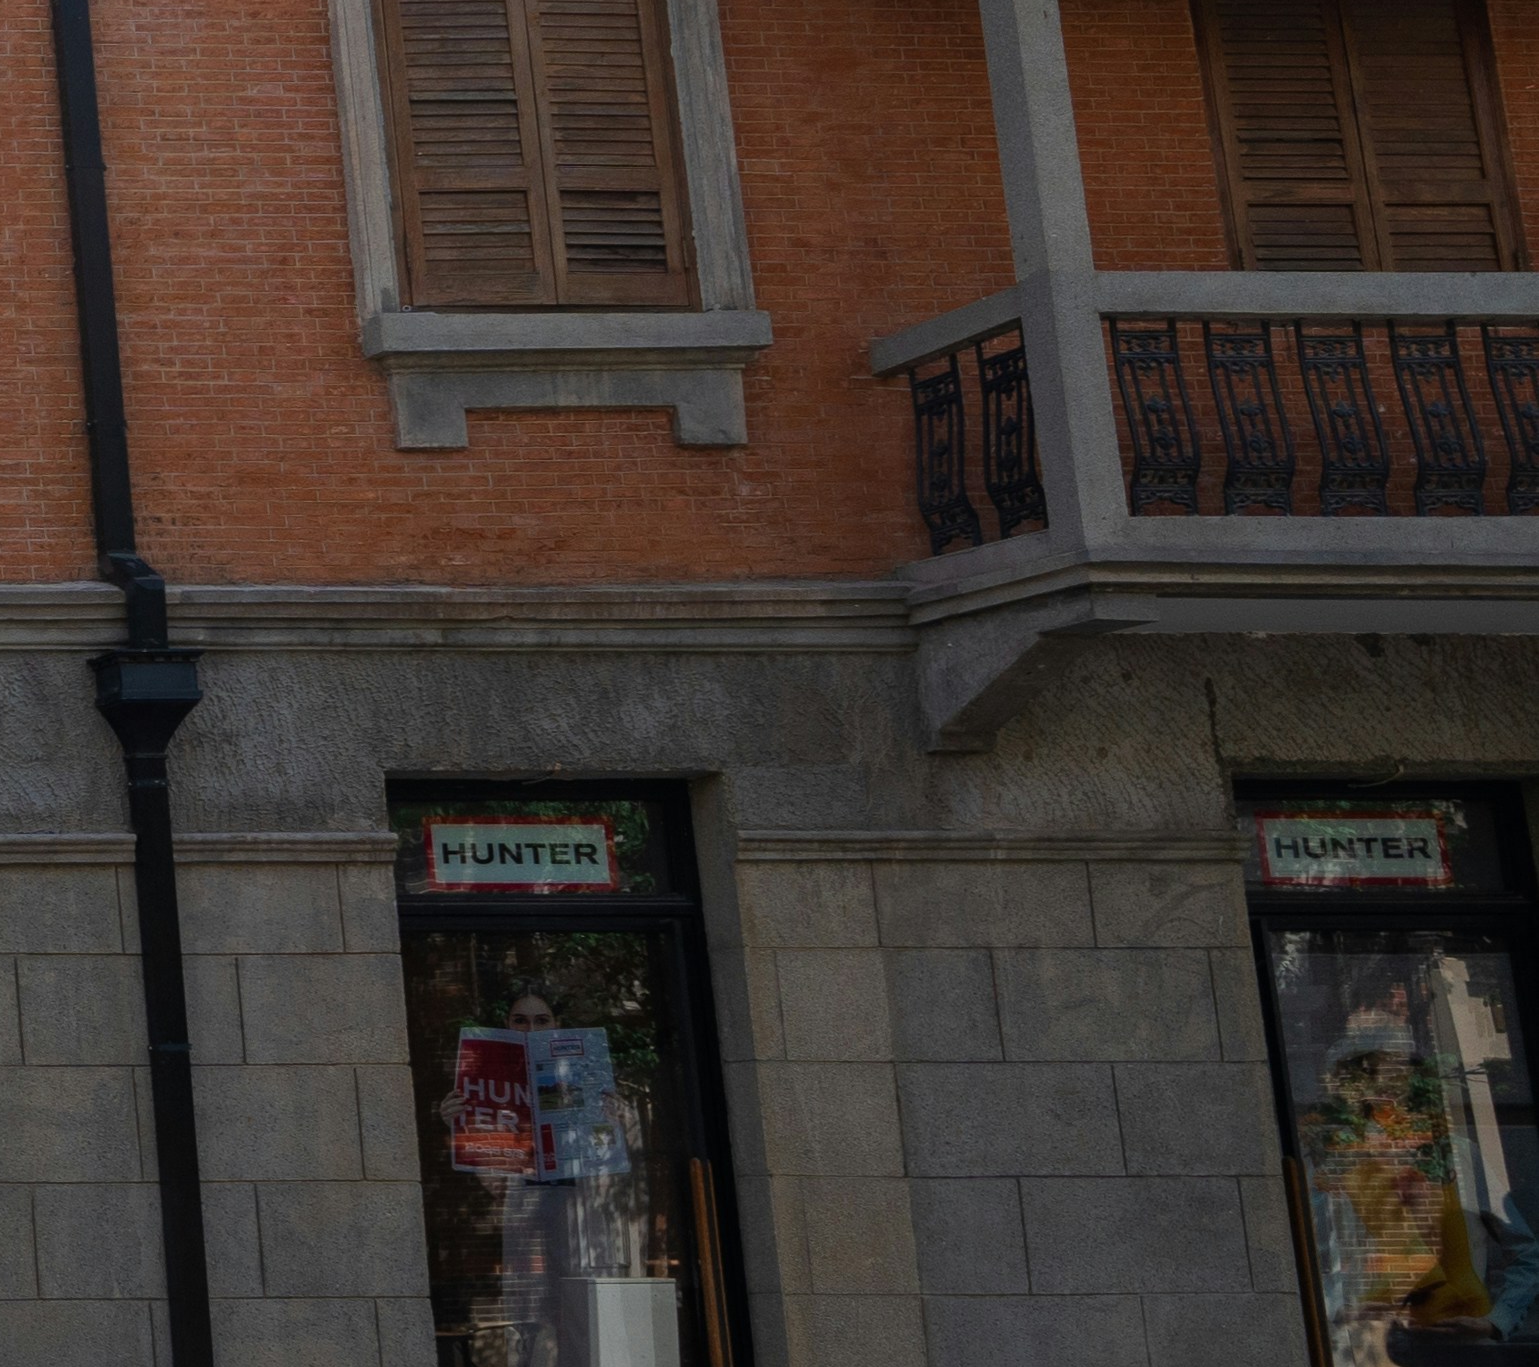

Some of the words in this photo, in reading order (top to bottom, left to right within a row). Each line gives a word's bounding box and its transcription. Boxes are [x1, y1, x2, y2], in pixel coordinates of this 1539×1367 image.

[441, 842, 600, 866] HUNTER
[1273, 836, 1432, 860] HUNTER
[463, 1076, 532, 1107] HUN
